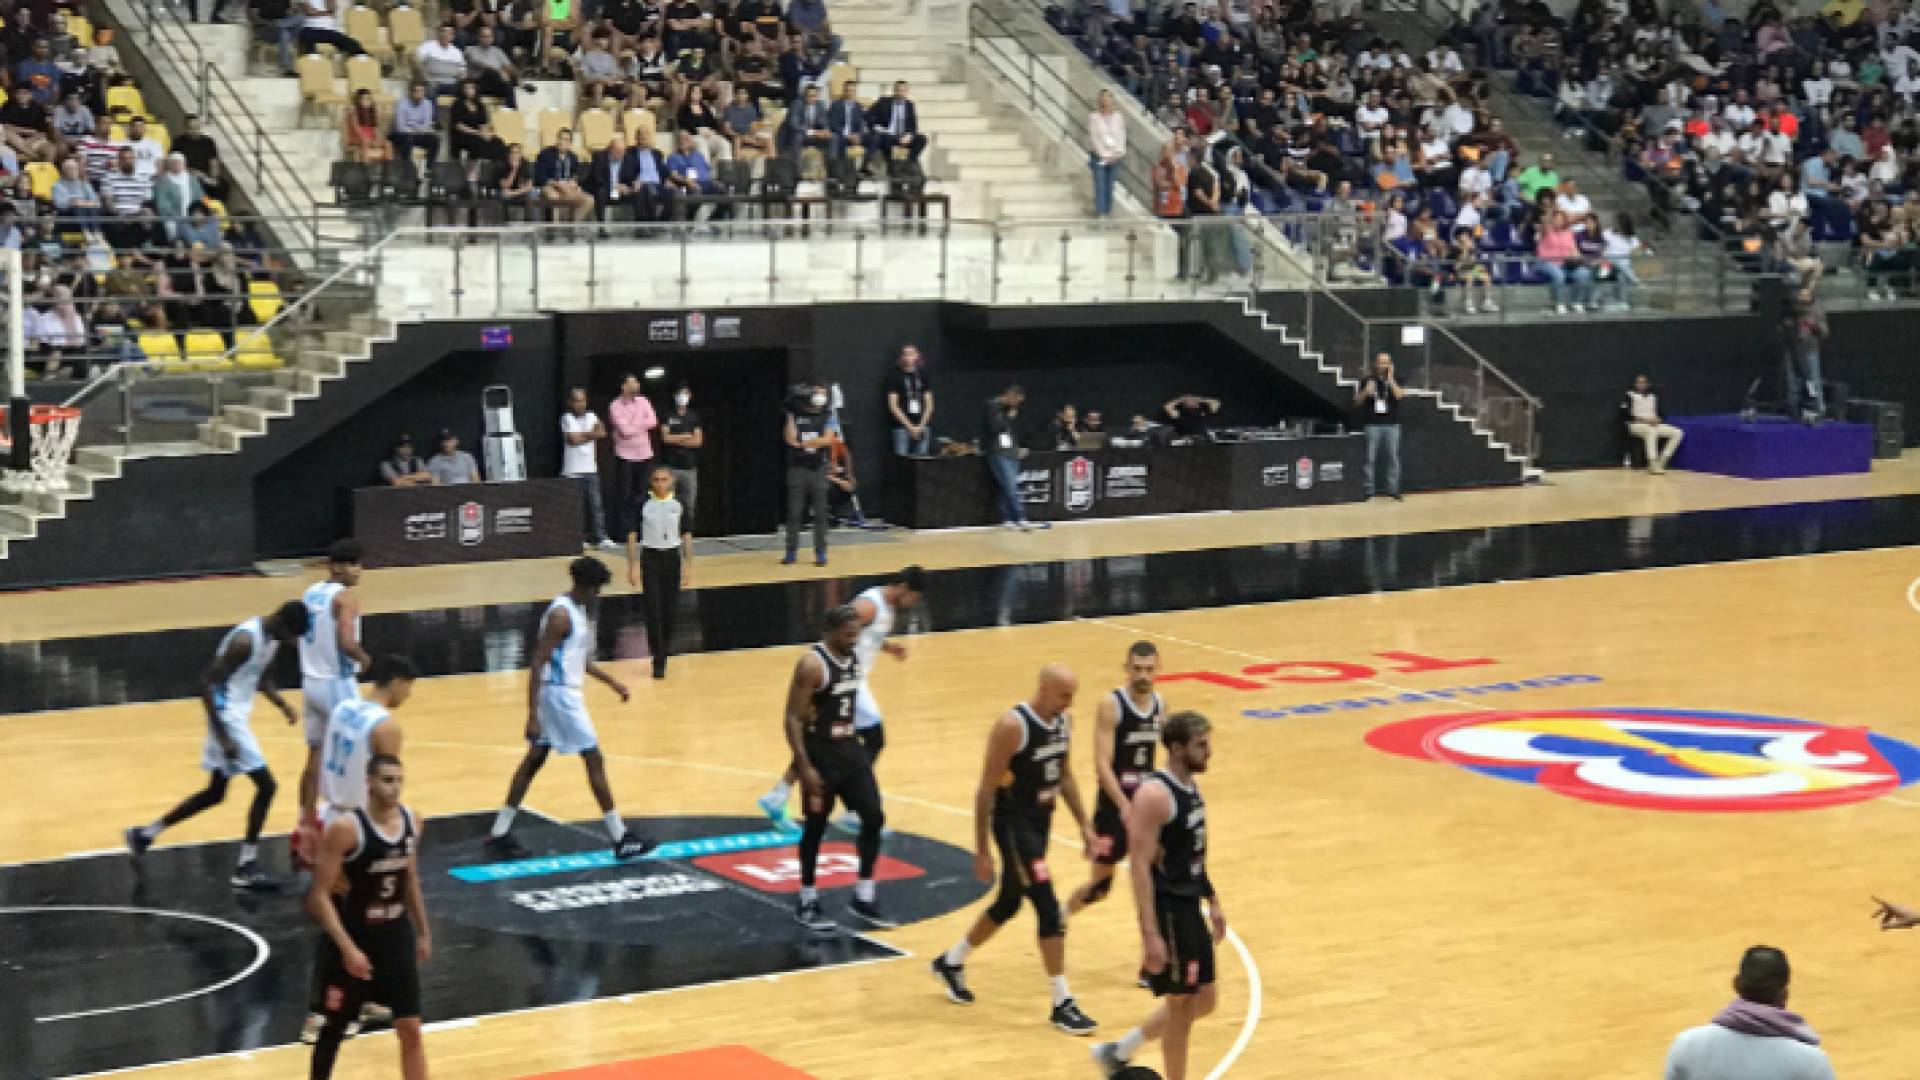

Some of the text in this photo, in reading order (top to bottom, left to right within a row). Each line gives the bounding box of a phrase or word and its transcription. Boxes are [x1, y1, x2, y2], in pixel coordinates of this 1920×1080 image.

[1154, 651, 1500, 690] TCL
[1241, 673, 1603, 718] QUALIFIERS
[379, 874, 397, 899] 5
